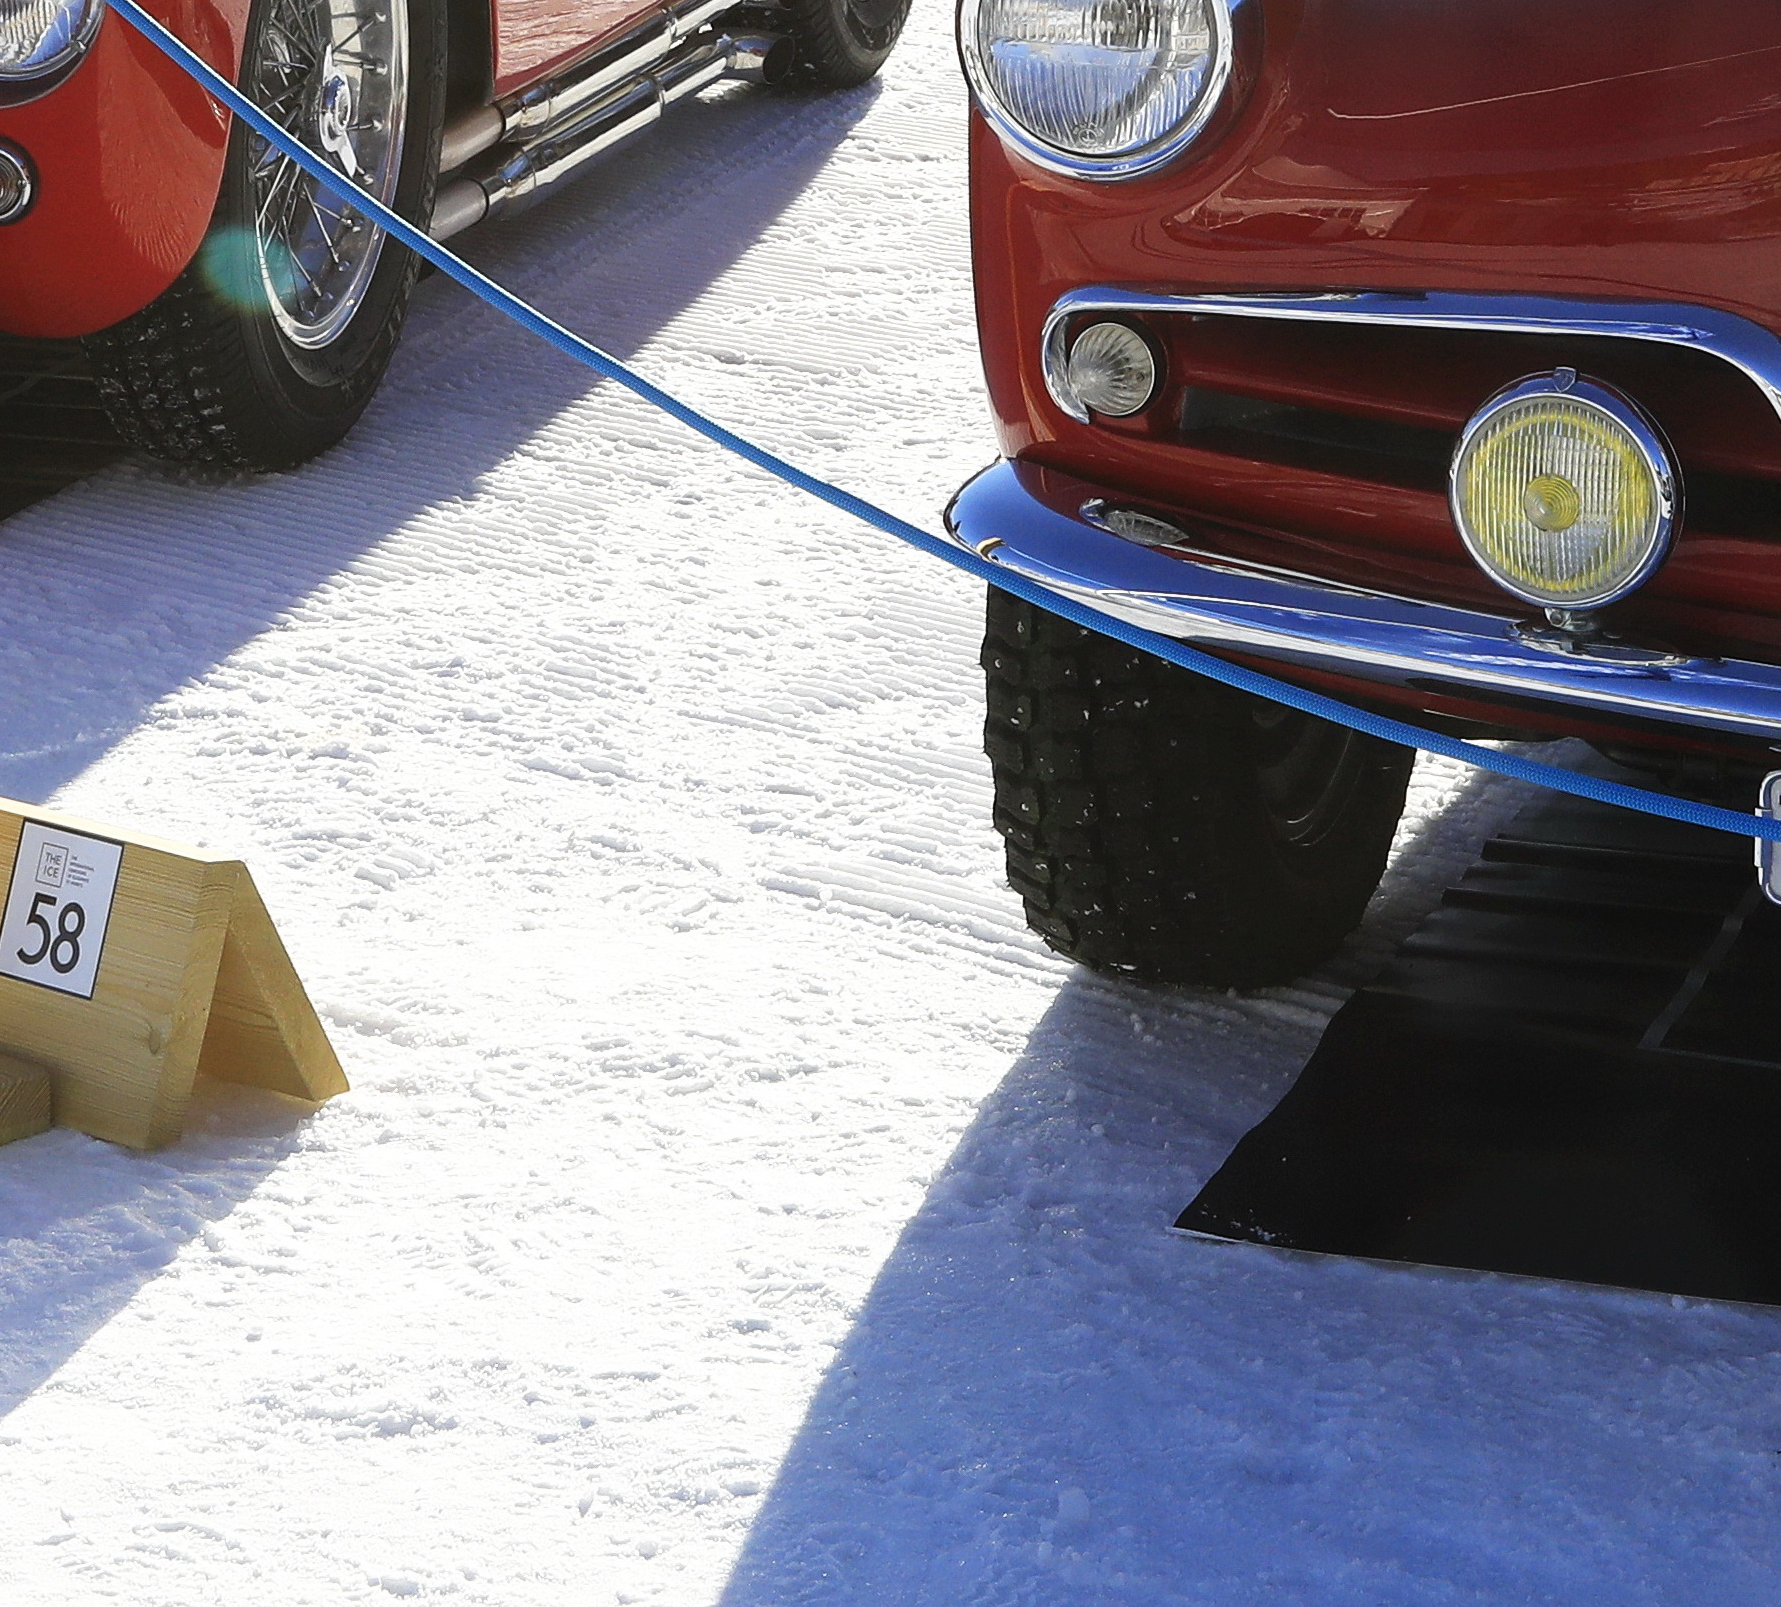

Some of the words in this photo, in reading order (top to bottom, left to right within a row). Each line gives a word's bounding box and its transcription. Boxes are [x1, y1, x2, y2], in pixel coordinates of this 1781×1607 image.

[45, 851, 62, 866] THE
[43, 863, 59, 879] ICE
[17, 892, 85, 974] 58
